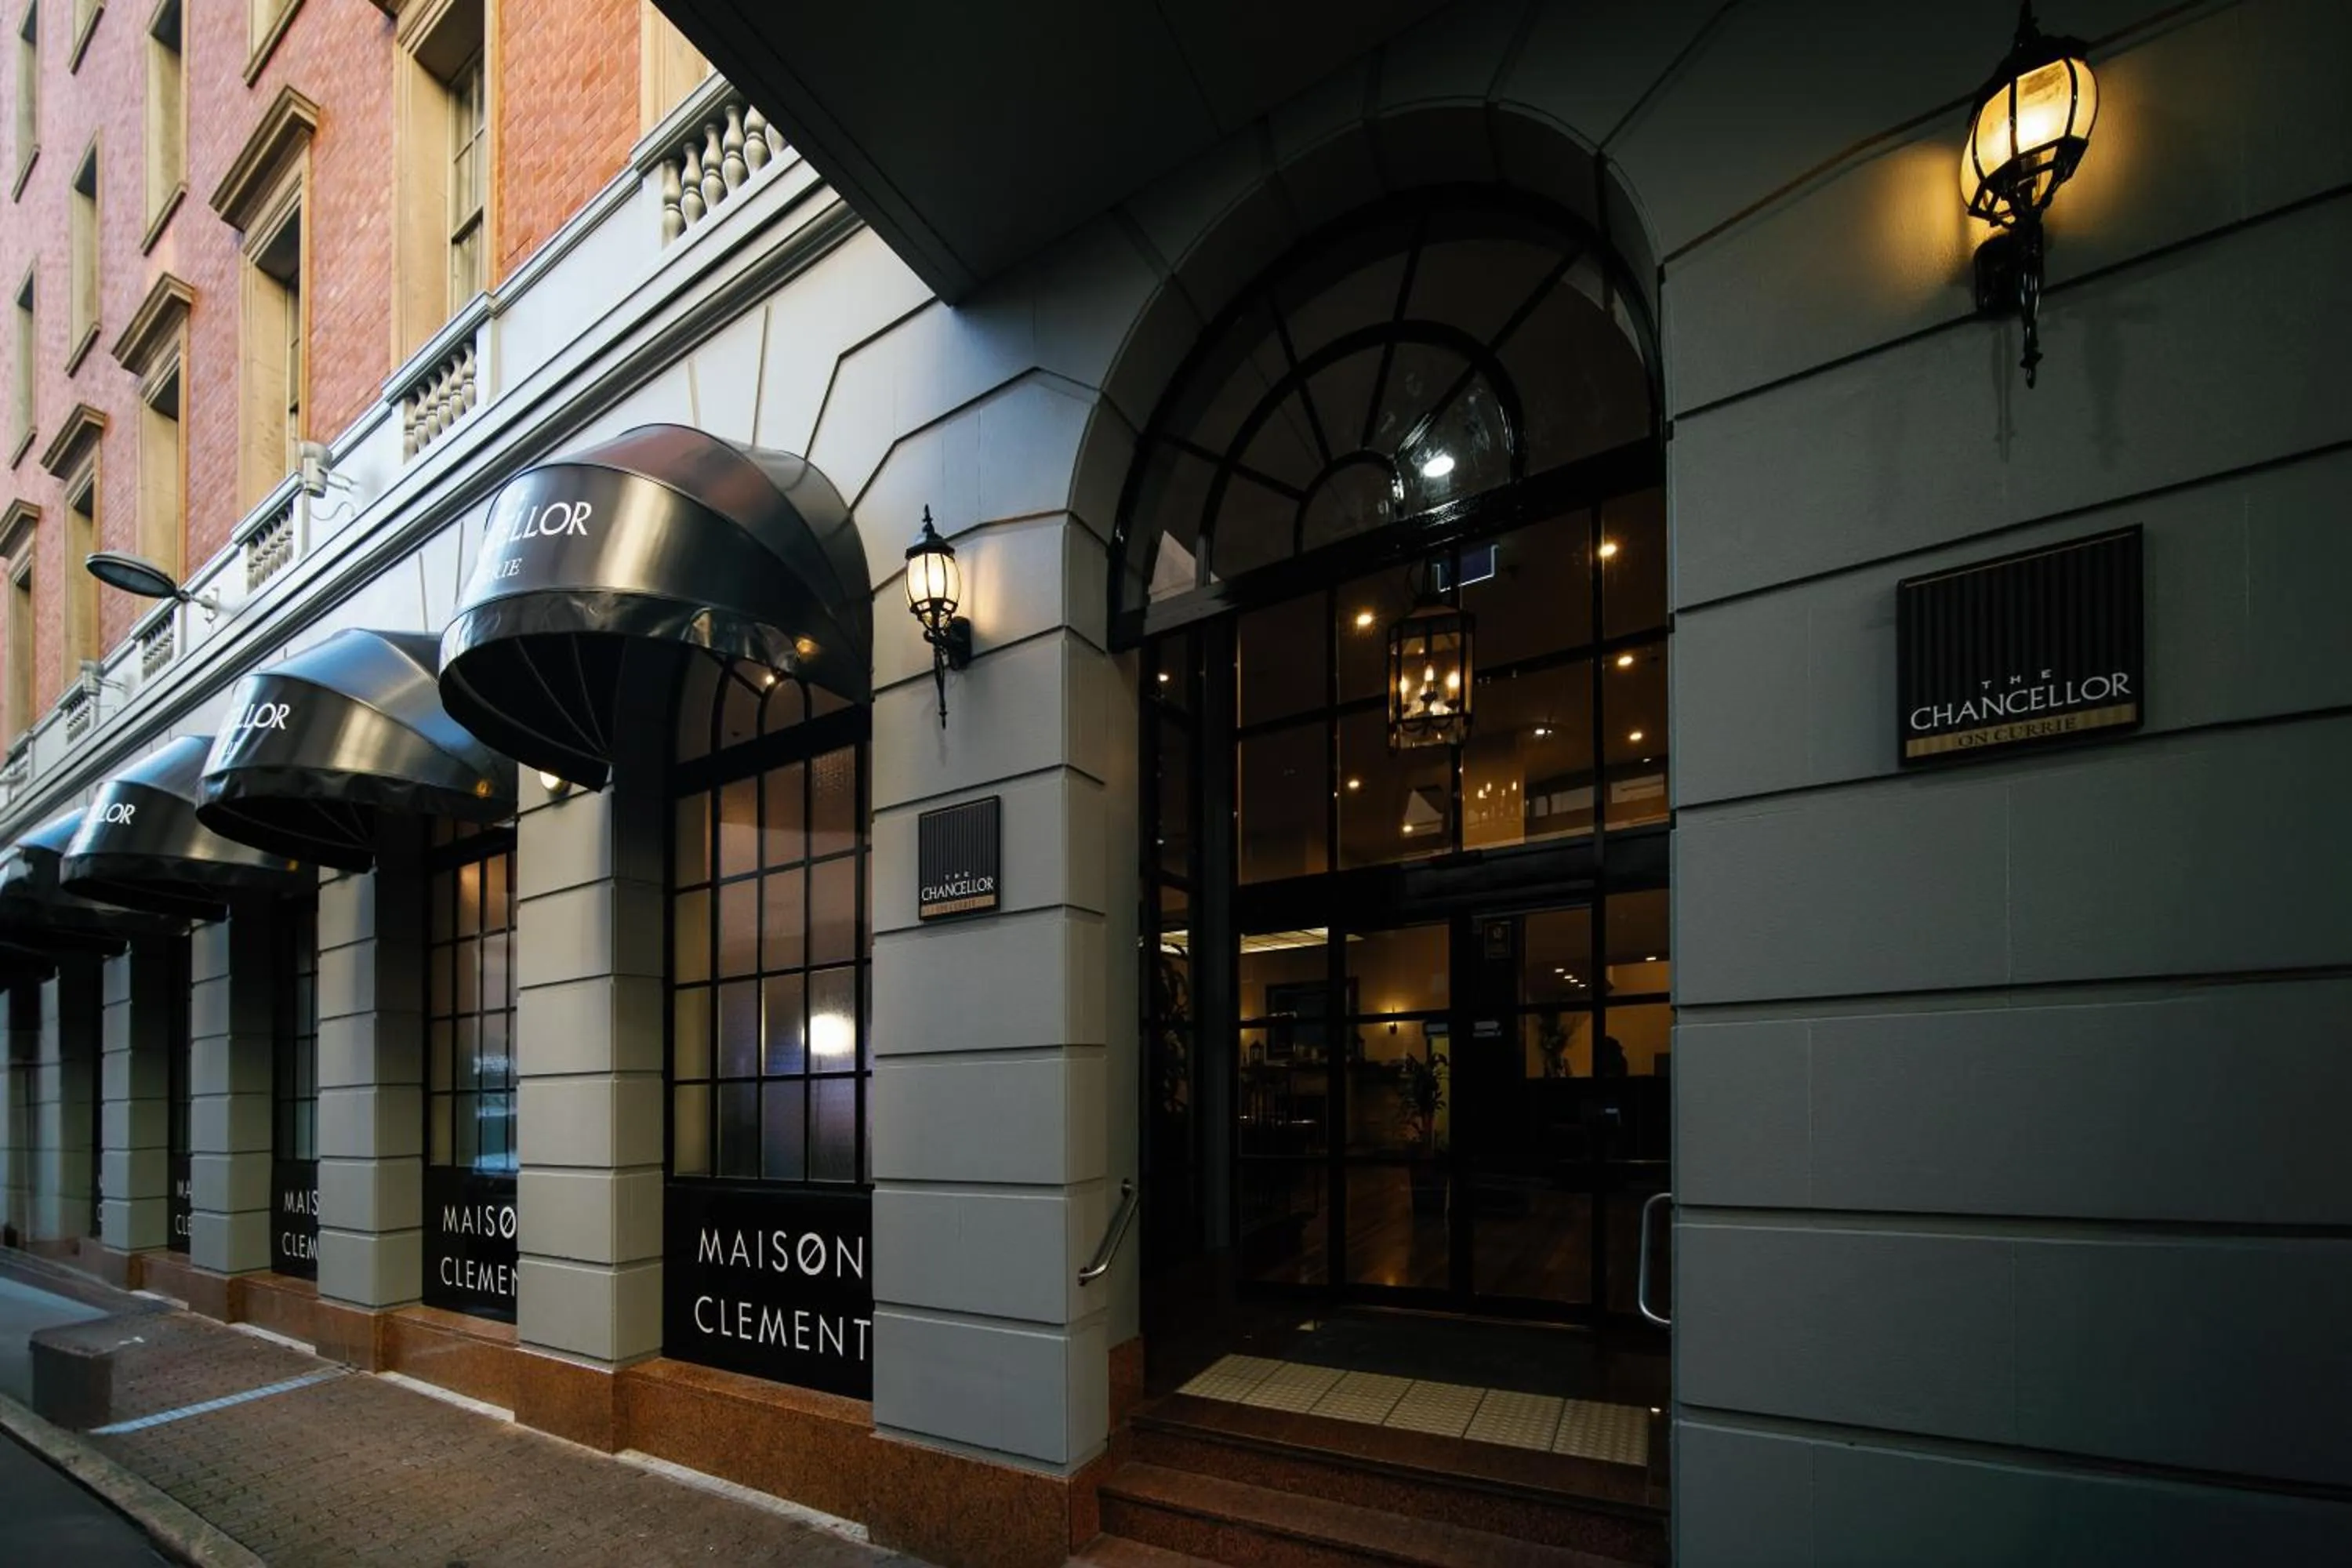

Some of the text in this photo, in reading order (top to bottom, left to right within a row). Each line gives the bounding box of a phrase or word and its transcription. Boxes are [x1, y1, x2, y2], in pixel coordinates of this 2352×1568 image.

[1982, 669, 2053, 689] THE
[1911, 672, 2132, 730] CHANCELLOR
[1958, 717, 2078, 747] ON CURRIE
[921, 877, 993, 901] CHANCELLOR
[695, 1295, 872, 1360] CLEMENT
